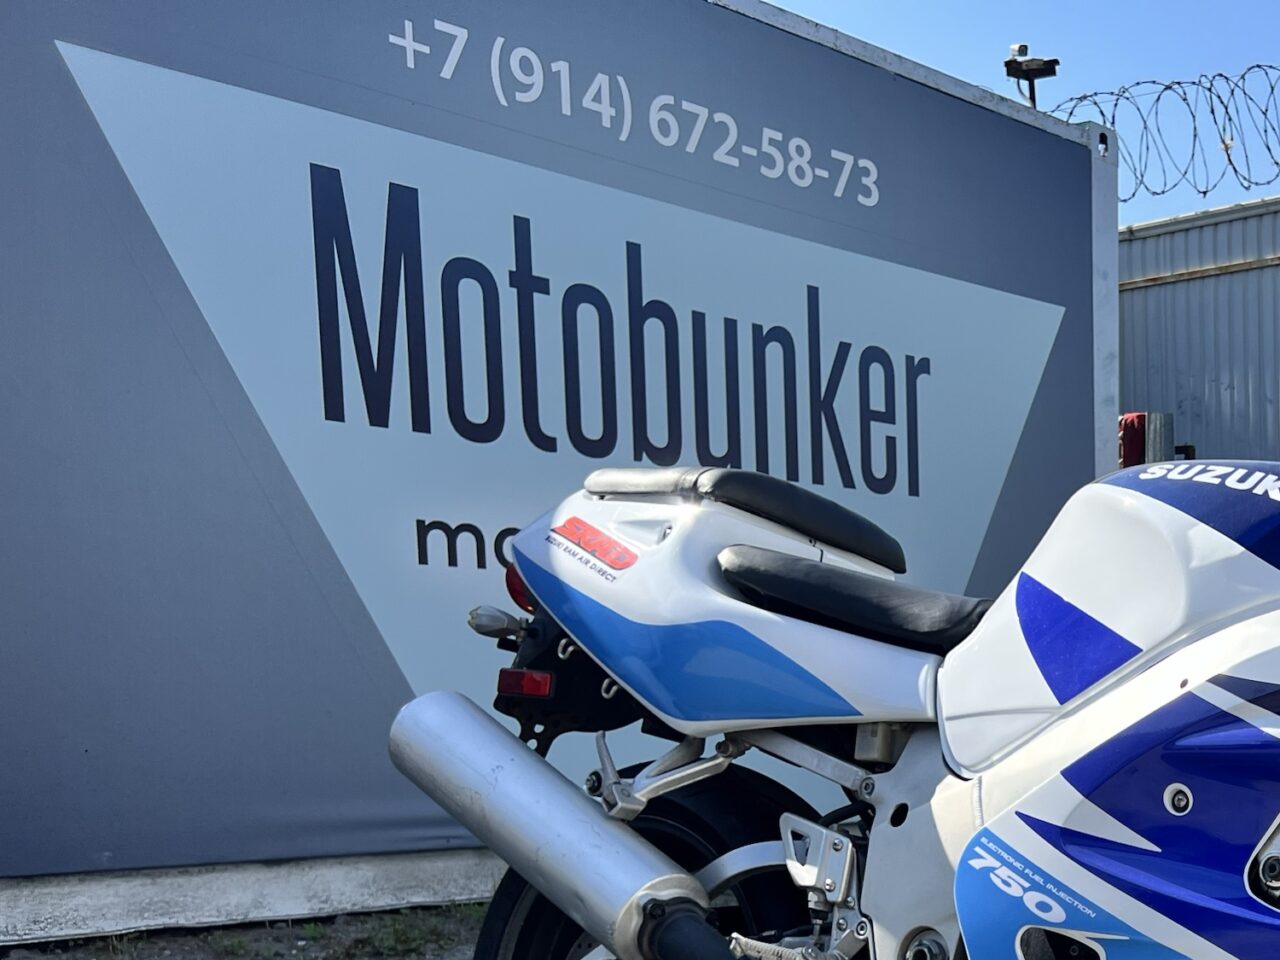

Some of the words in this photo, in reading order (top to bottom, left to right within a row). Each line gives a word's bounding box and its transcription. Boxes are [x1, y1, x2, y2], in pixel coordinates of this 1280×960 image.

[389, 19, 468, 80] +7
[490, 36, 633, 142] (914)
[648, 95, 880, 207] 672-58-73
[309, 162, 931, 497] Motobunker
[589, 563, 617, 583] DIRECT
[968, 846, 1066, 923] 750
[980, 836, 1025, 871] ELECTRONIC
[1023, 868, 1046, 886] FUEL
[1046, 883, 1097, 918] INJECTION
